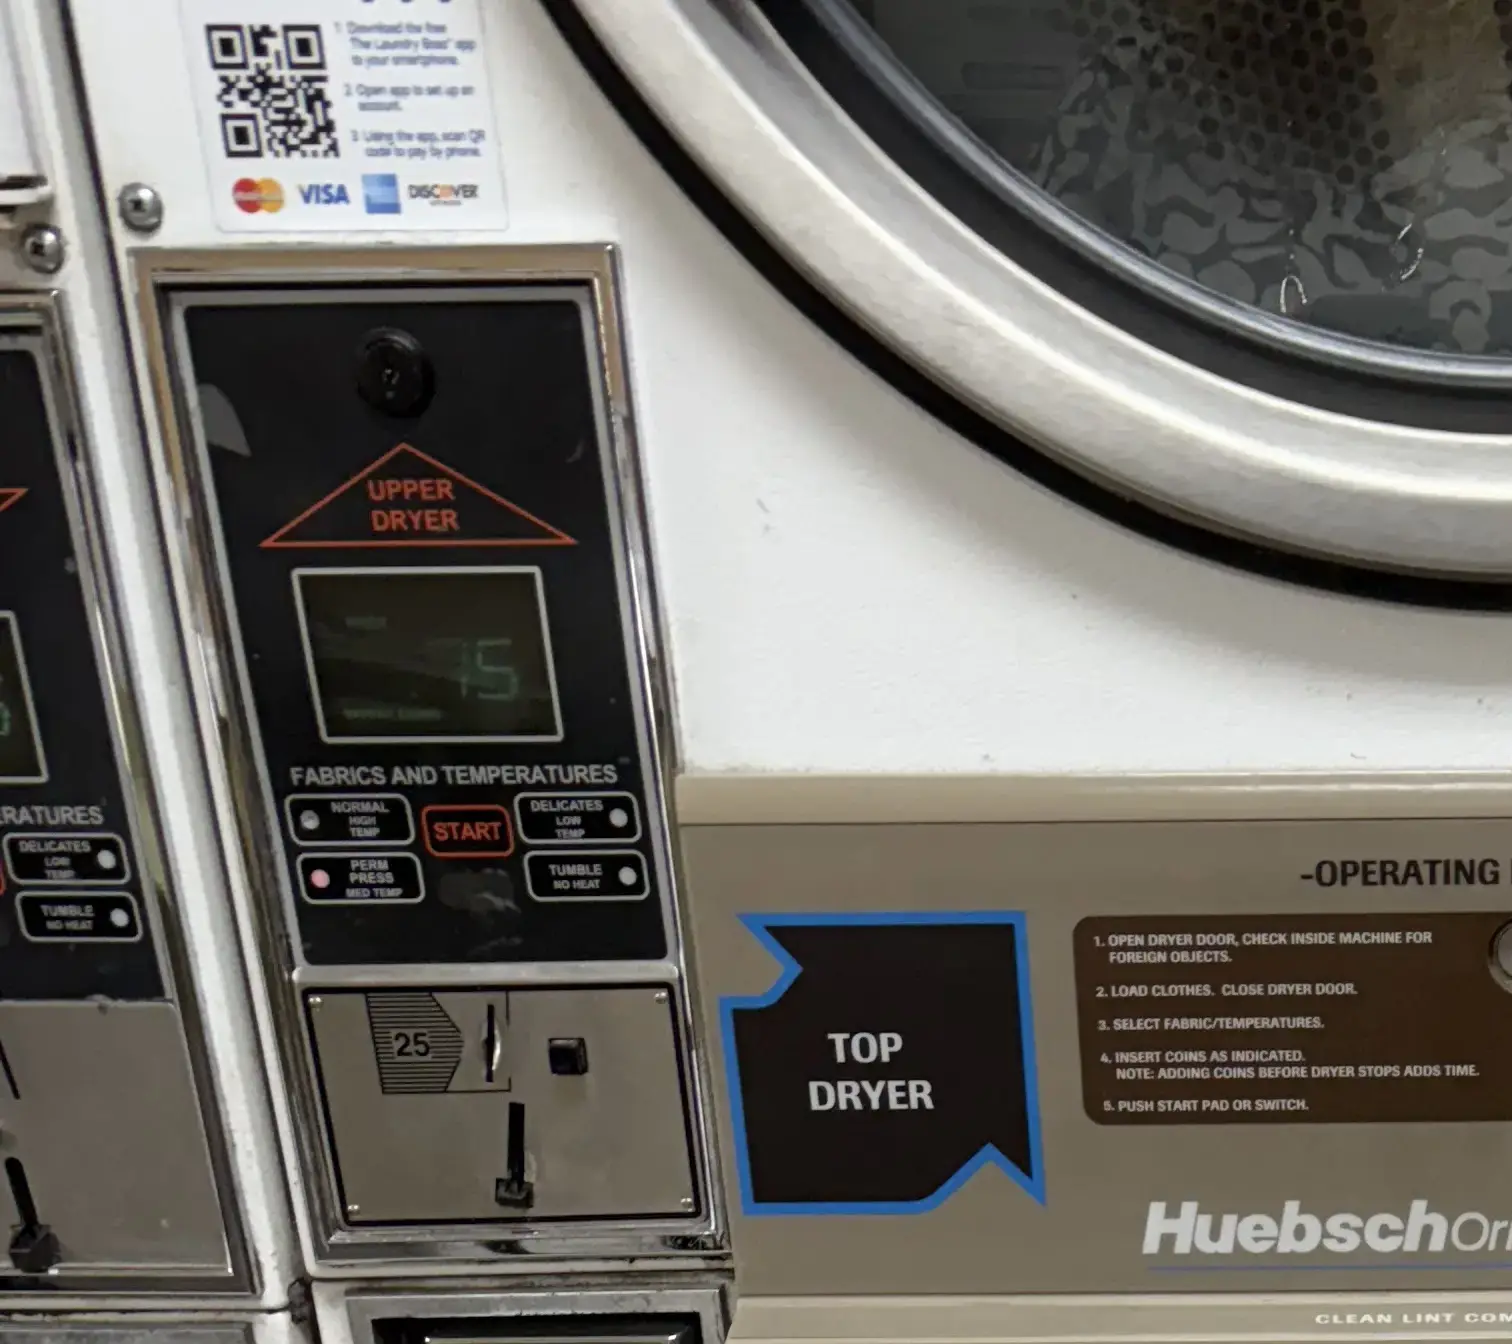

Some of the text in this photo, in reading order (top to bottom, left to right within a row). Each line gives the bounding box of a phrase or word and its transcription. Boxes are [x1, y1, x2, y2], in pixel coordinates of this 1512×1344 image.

[298, 184, 351, 205] VISA
[408, 184, 479, 201] DISCOVER
[366, 479, 456, 502] UPPER
[370, 509, 460, 533] DRYER
[290, 764, 618, 785] FABRICS AND TEMPERATURES
[330, 801, 390, 813] NORMAL
[530, 800, 603, 812] DELICATES
[433, 822, 502, 841] START
[350, 859, 389, 871] PERM
[549, 864, 603, 876] TUMBLE
[349, 872, 395, 884] PRESS
[1107, 934, 1145, 947] OPEN
[1147, 933, 1193, 946] DRYER
[1195, 933, 1239, 946] DOOR,
[1242, 932, 1288, 945] CHECK
[1290, 932, 1336, 945] INSIDE
[1339, 931, 1402, 944] MACHINE
[1405, 931, 1433, 944] FOR
[1109, 950, 1233, 964] FOREIGN OBJECTS.
[1111, 984, 1148, 997] LOAD
[1151, 984, 1215, 997] CLOTHES.
[1221, 983, 1265, 996] CLOSE
[1267, 983, 1312, 996] DRYER
[1315, 982, 1358, 995] DOOR.
[1113, 1018, 1161, 1031] SELECT
[1163, 1016, 1325, 1030] FABRIC/TEMPERATURES.
[394, 1032, 432, 1058] 25
[827, 1032, 903, 1063] TOP
[1115, 1051, 1162, 1063] INSERT
[1164, 1050, 1207, 1063] COINS
[1209, 1050, 1228, 1062] AS
[1231, 1050, 1306, 1062] INDICATED.
[1116, 1064, 1480, 1080] NOTE: ADDING COINS BEFORE DRYER STOPS ADDS TIME.
[808, 1079, 935, 1111] DRYER
[1118, 1100, 1154, 1112] PUSH
[1157, 1099, 1199, 1112] START
[1201, 1099, 1230, 1111] PAD
[1232, 1099, 1252, 1111] OR
[1254, 1098, 1309, 1111] SWITCH.
[1315, 1313, 1393, 1326] CLEAN
[1402, 1312, 1455, 1325] LINT
